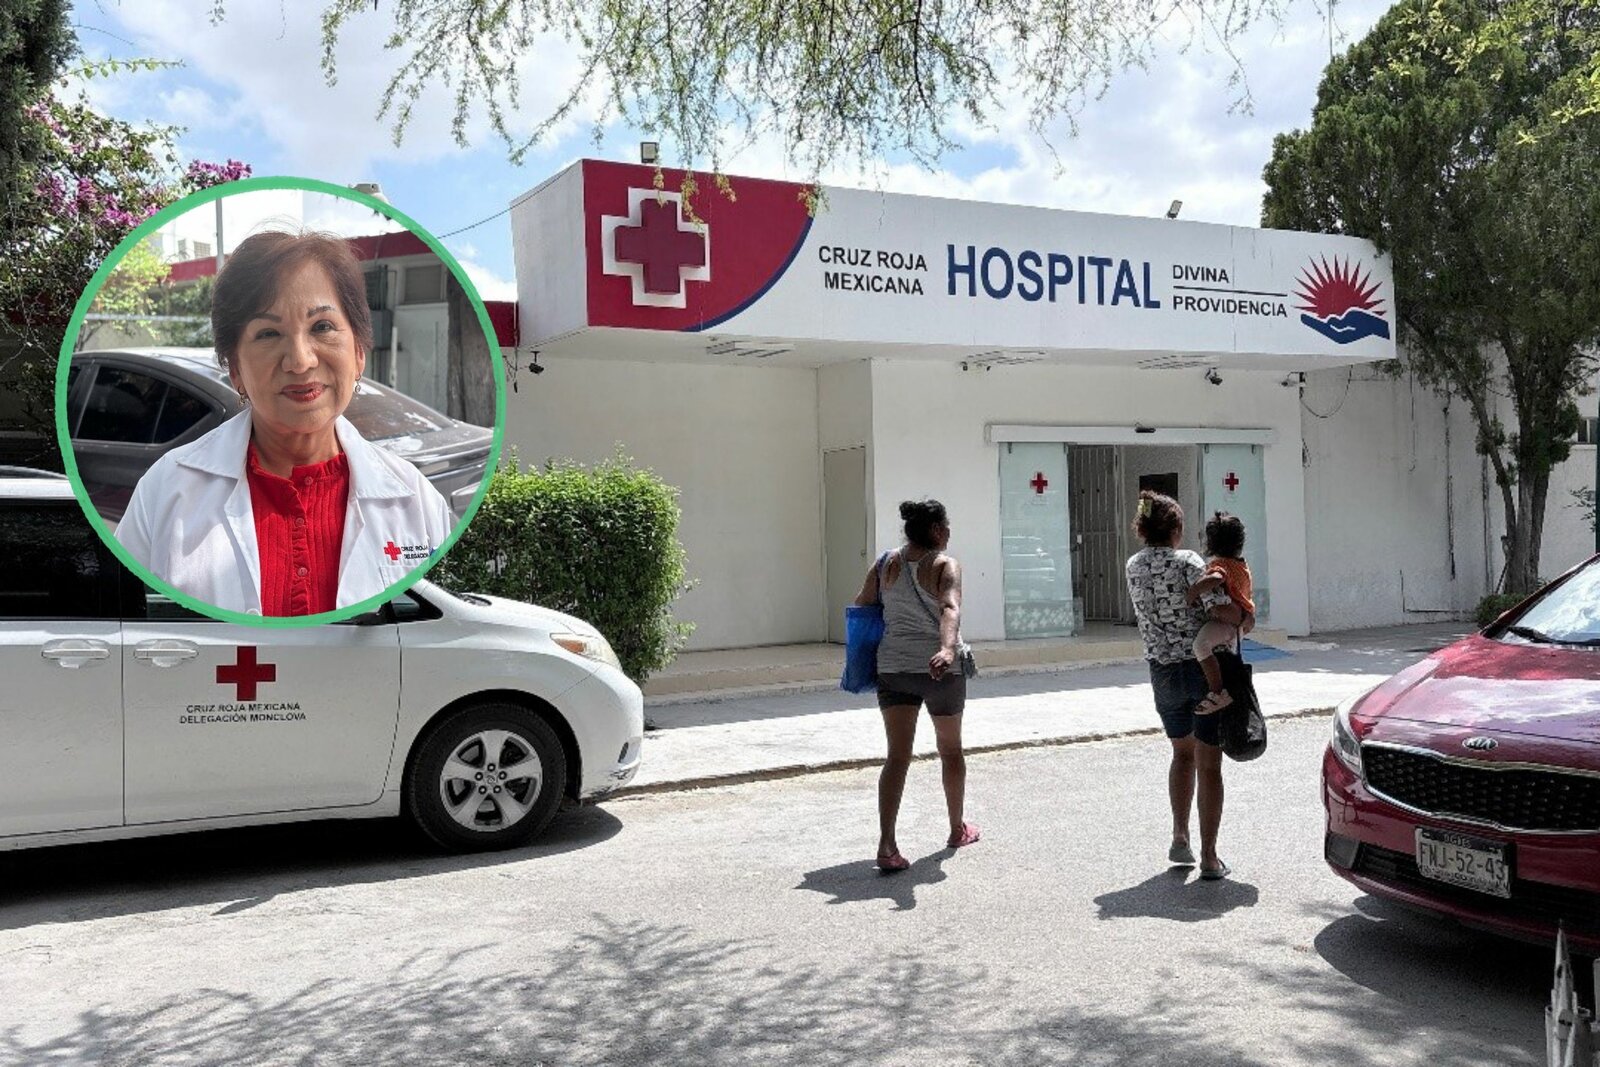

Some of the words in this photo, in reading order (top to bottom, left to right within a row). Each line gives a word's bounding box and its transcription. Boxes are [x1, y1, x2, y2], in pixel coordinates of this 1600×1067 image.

[818, 245, 872, 267] CRUZ
[877, 250, 928, 272] ROJA
[824, 271, 924, 296] MEXICANA
[946, 244, 1161, 309] HOSPITAL
[1173, 264, 1230, 283] DIVINA
[1173, 295, 1288, 317] PROVIDENCIA
[179, 713, 247, 724] DELEGACIÓN
[250, 712, 307, 722] MONCLOVA
[186, 704, 215, 713] CRUZ
[217, 703, 246, 713] ROJA
[248, 702, 301, 712] MEXICANA
